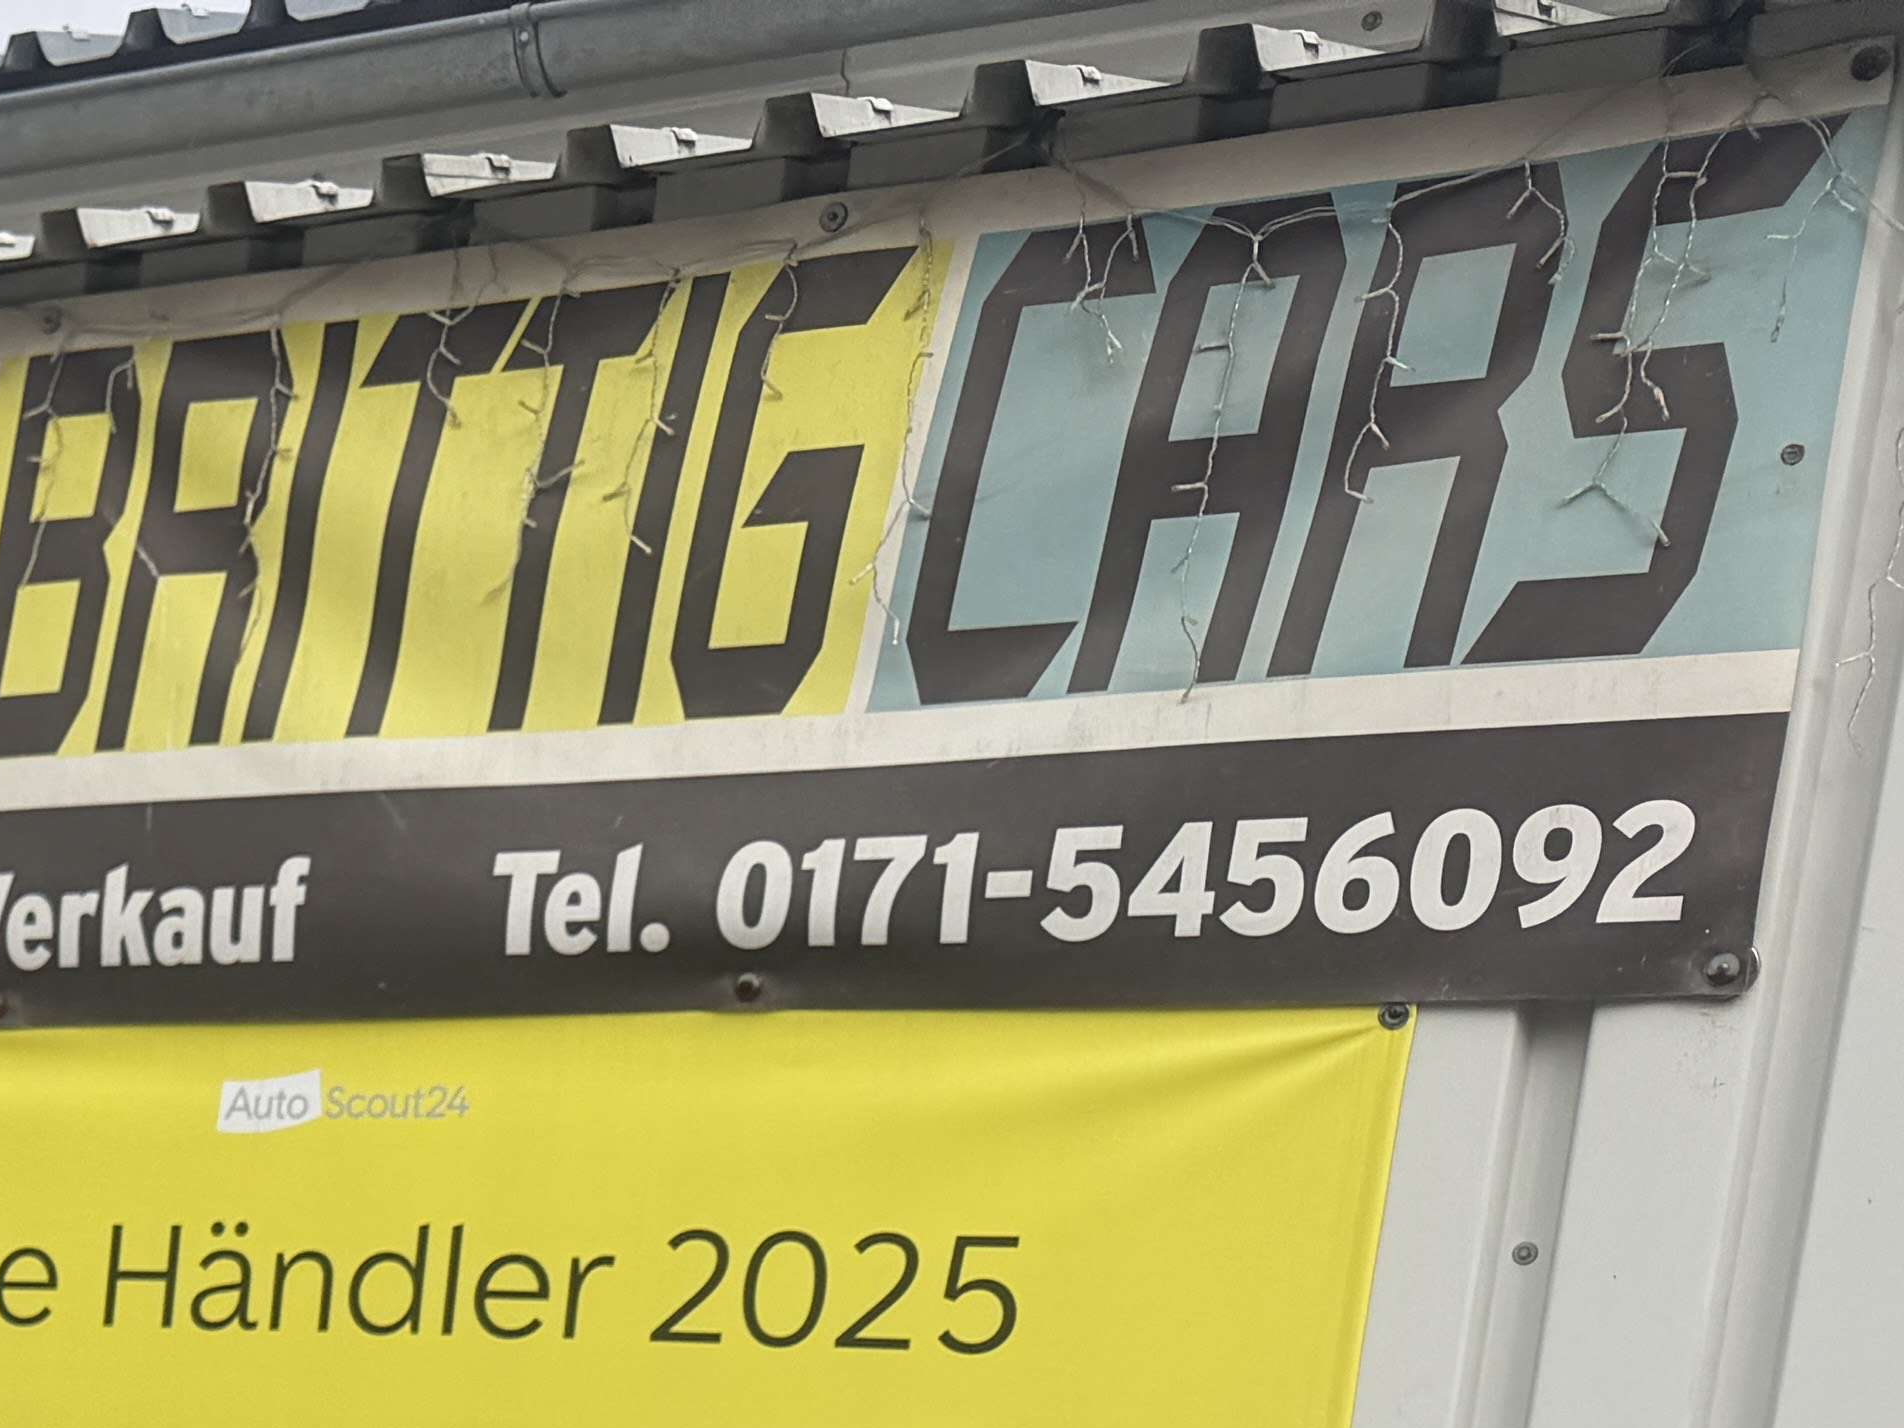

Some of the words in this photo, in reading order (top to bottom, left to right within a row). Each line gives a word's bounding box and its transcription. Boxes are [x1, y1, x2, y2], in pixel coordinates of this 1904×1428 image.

[907, 113, 1852, 706] CARS
[493, 843, 672, 956] Tel.
[716, 800, 1697, 949] 0171-5456092
[224, 1086, 310, 1120] Auto
[325, 1082, 470, 1120] Scout24
[102, 1219, 615, 1341] Händler
[650, 1227, 1023, 1355] 2025
